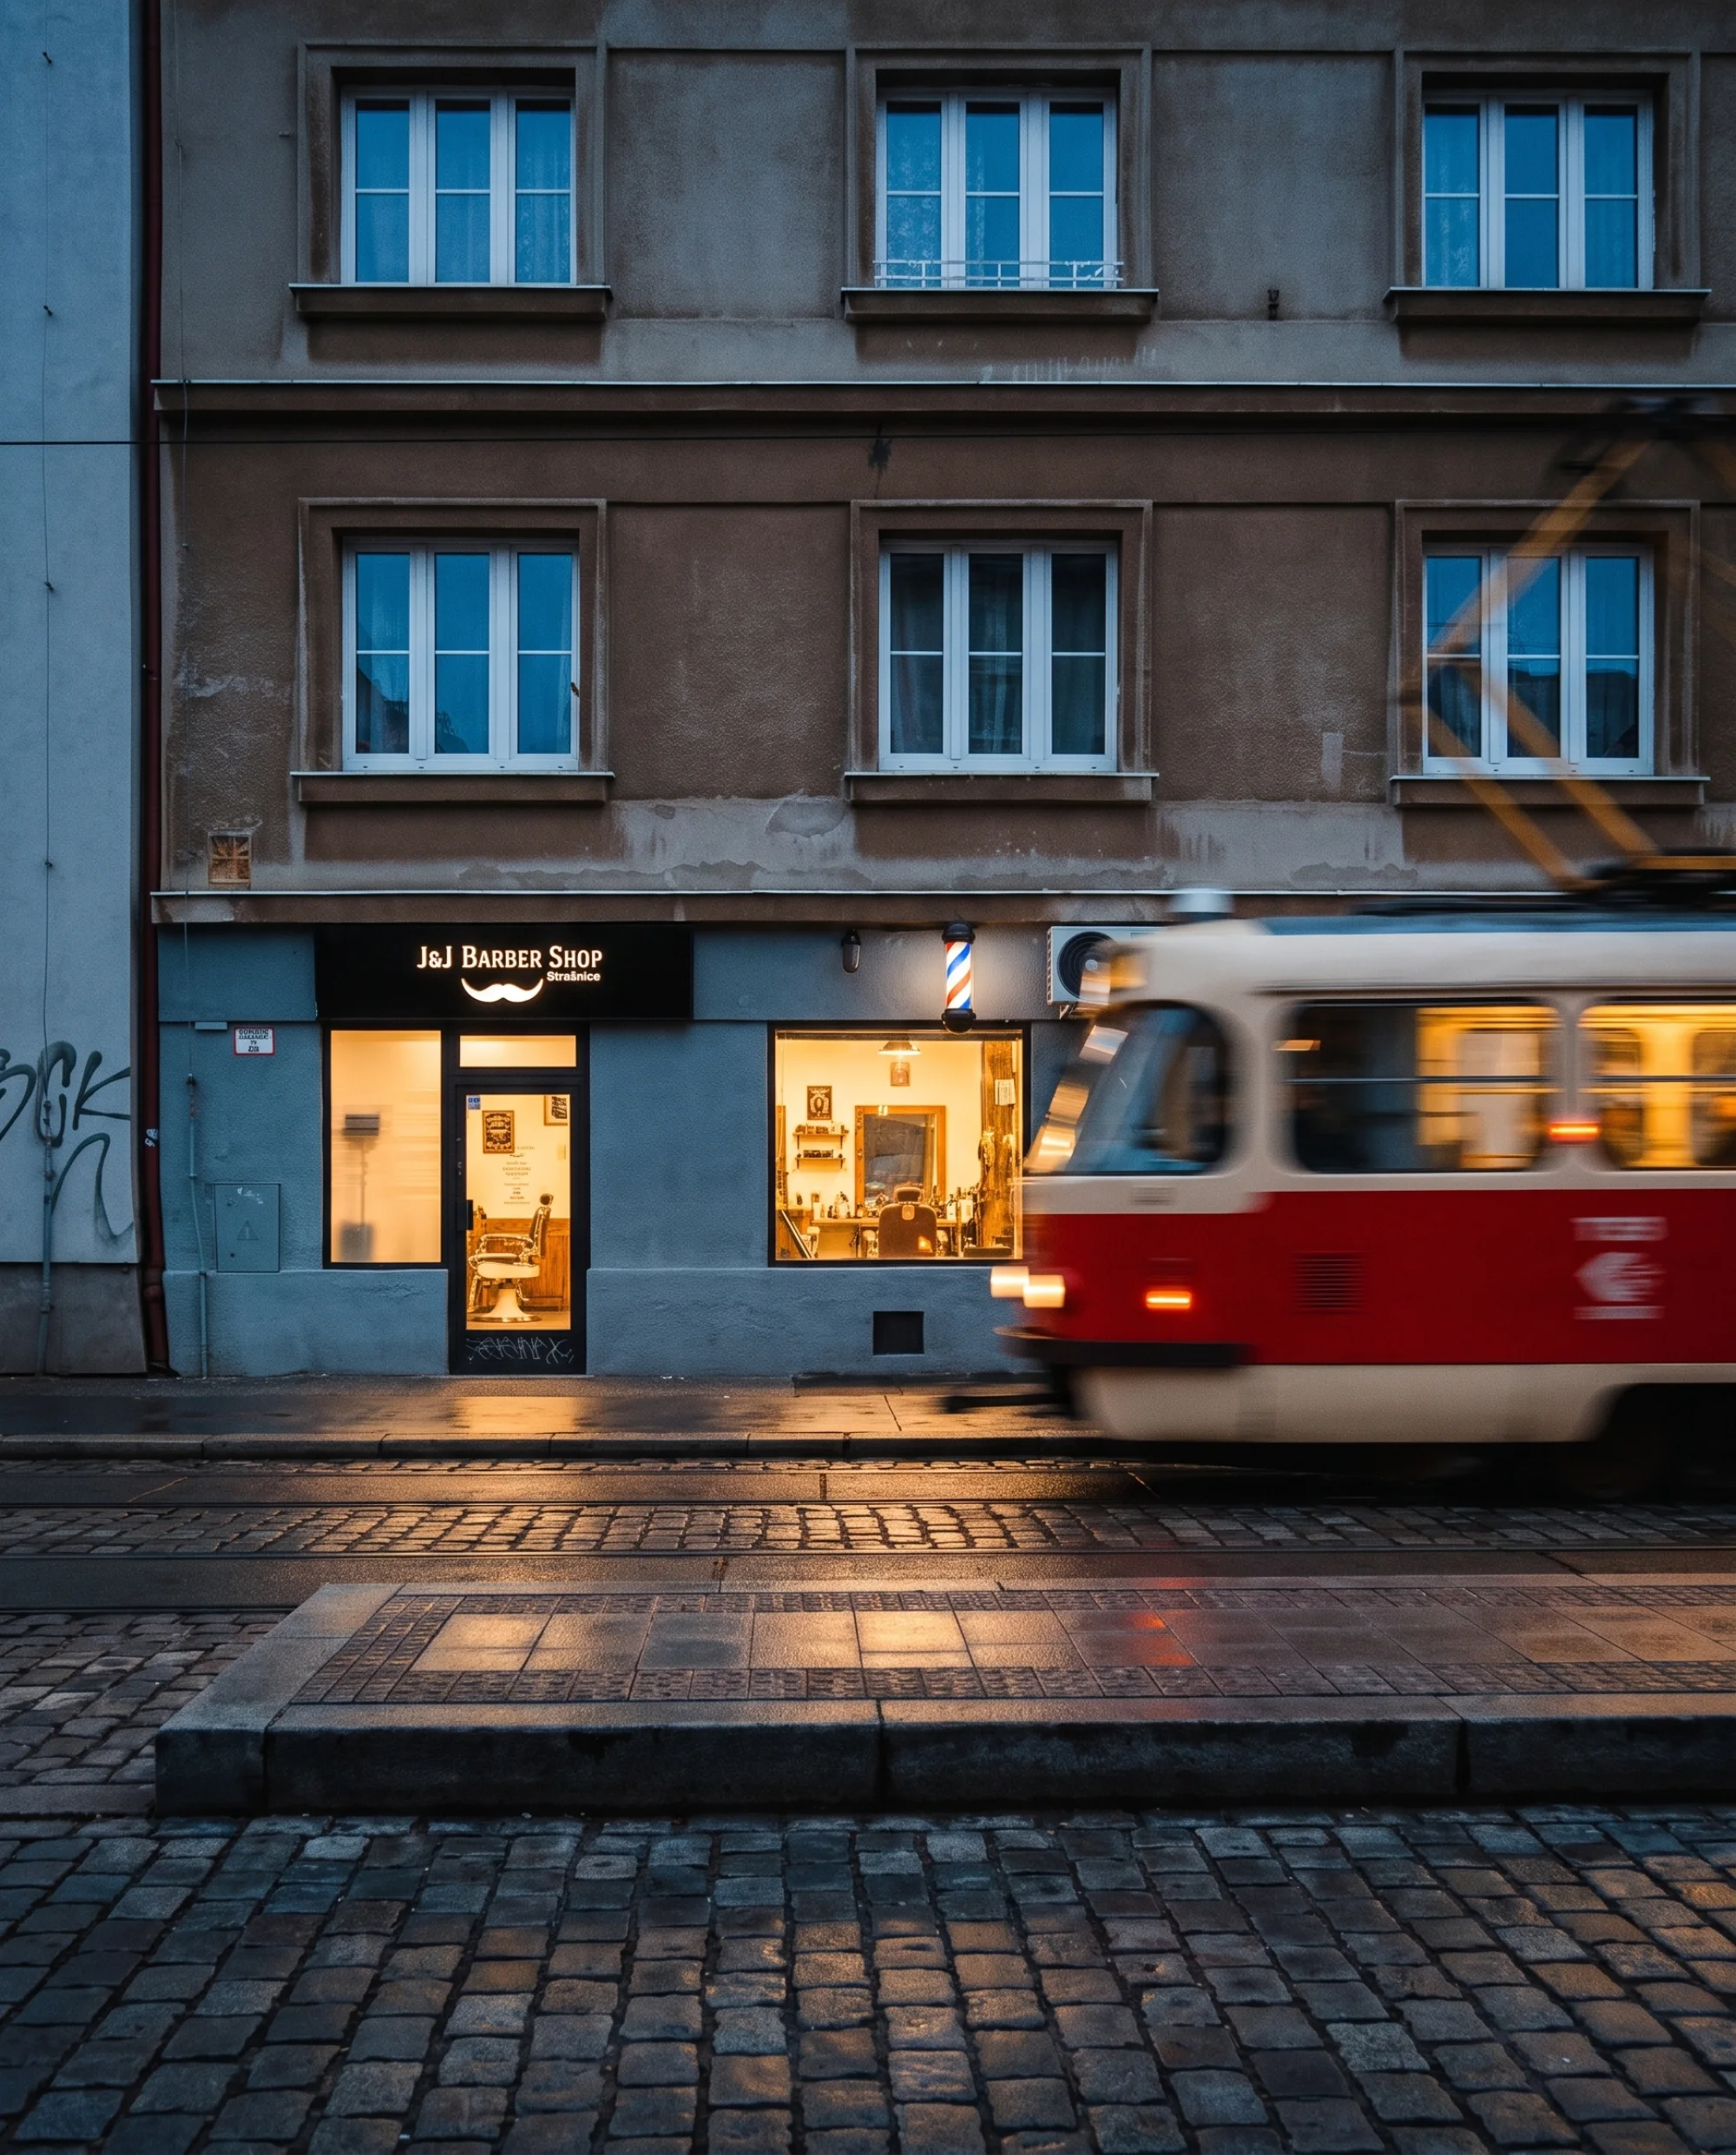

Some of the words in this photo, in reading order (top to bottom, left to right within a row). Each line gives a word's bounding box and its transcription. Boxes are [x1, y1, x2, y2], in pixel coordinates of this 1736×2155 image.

[416, 945, 452, 969] J&J
[461, 945, 542, 969] BARBER
[549, 944, 603, 969] SHOP
[546, 970, 602, 982] Strašnice
